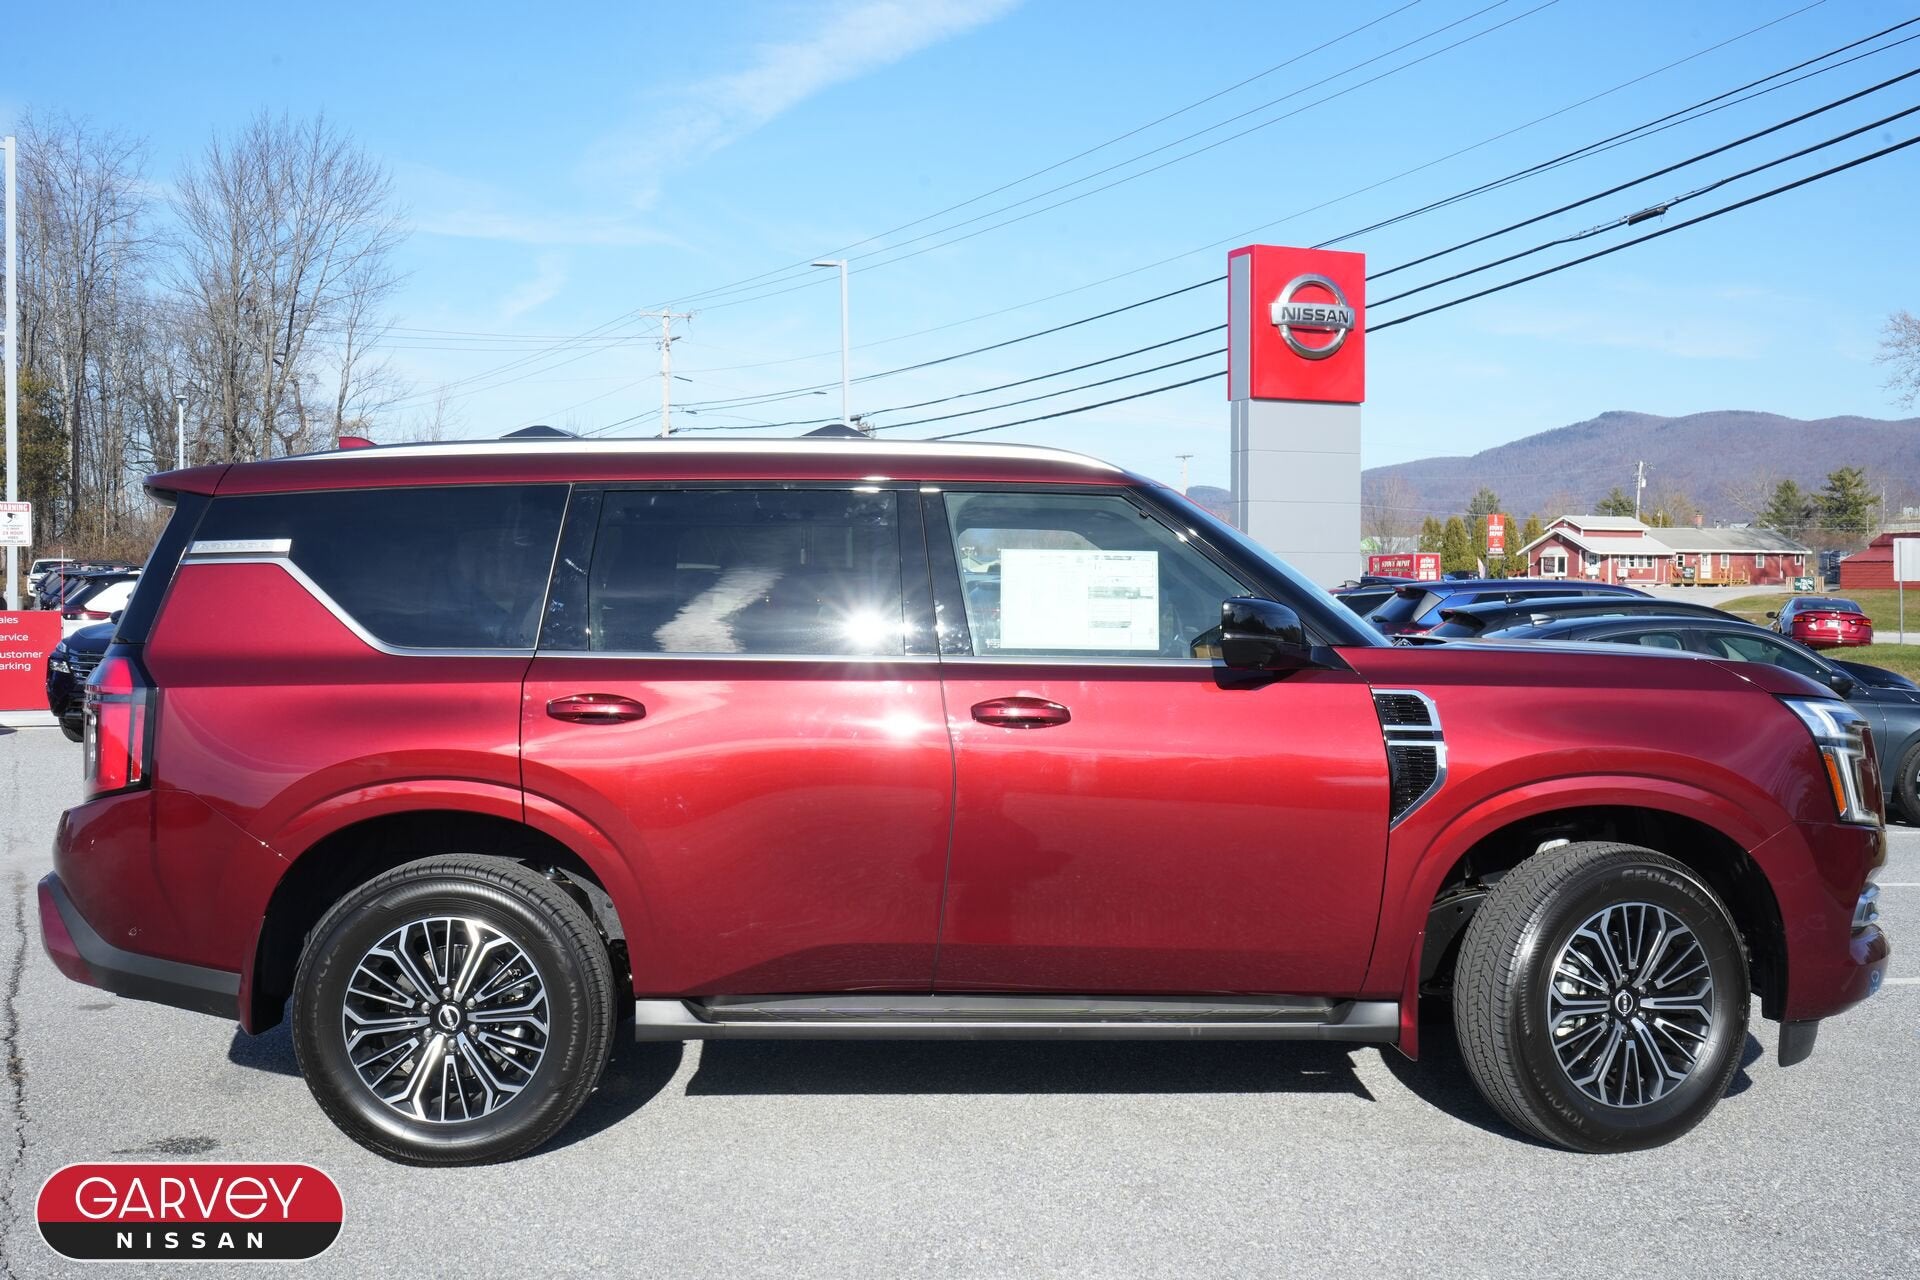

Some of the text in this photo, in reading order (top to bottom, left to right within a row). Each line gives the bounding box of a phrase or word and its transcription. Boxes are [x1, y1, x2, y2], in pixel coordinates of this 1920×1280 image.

[1282, 306, 1349, 323] NISSAN
[0, 616, 19, 624] ales
[0, 633, 29, 641] ervice
[0, 651, 44, 659] ustomer
[0, 662, 31, 671] arking
